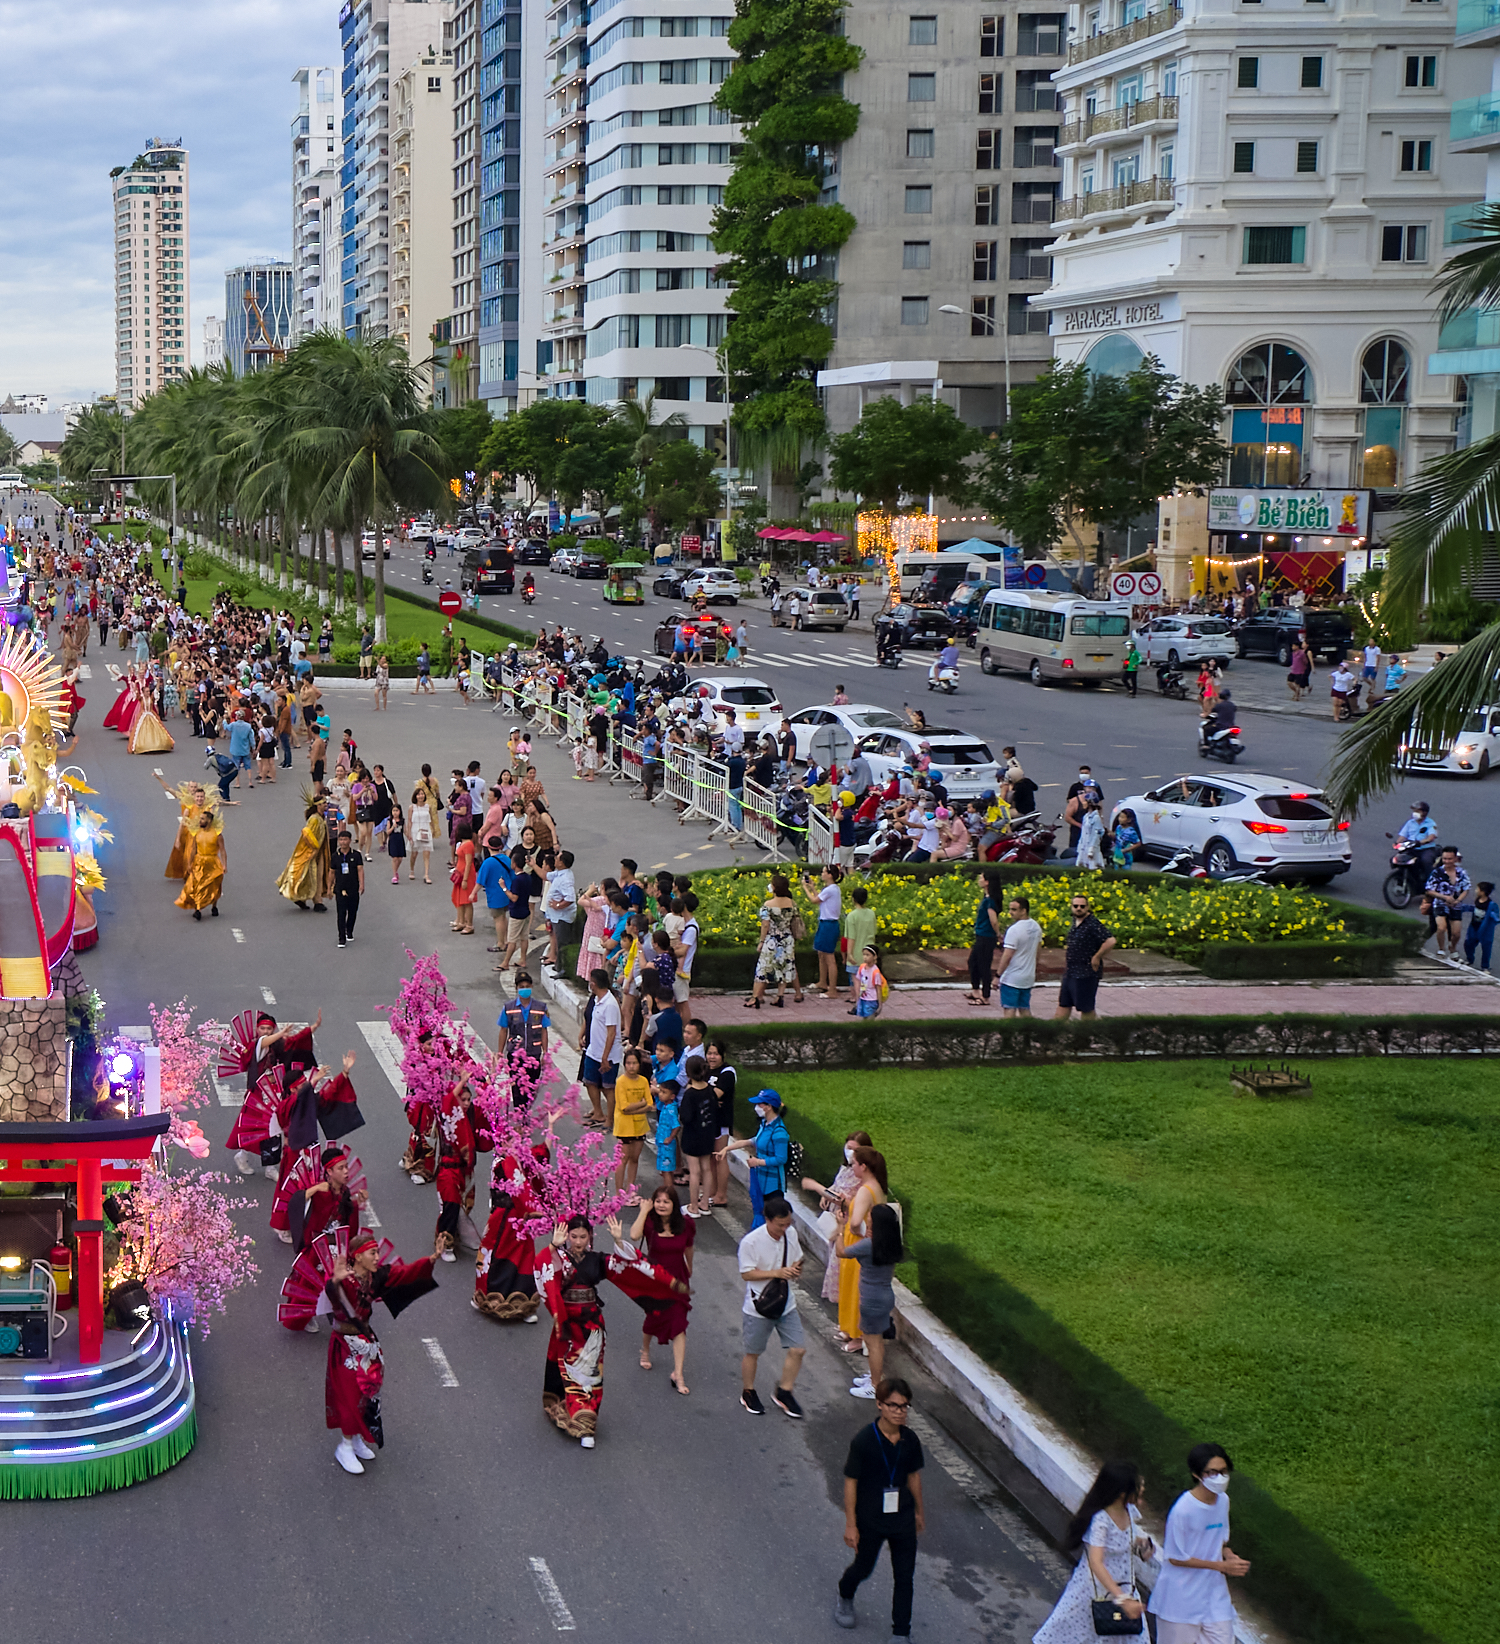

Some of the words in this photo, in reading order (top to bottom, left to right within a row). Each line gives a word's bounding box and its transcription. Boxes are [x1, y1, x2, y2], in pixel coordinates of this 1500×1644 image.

[1065, 306, 1121, 331] PARACEL
[1126, 303, 1163, 324] HOTEL
[1257, 496, 1282, 528] Bé
[1285, 490, 1330, 528] Biển
[1119, 579, 1130, 588] 40
